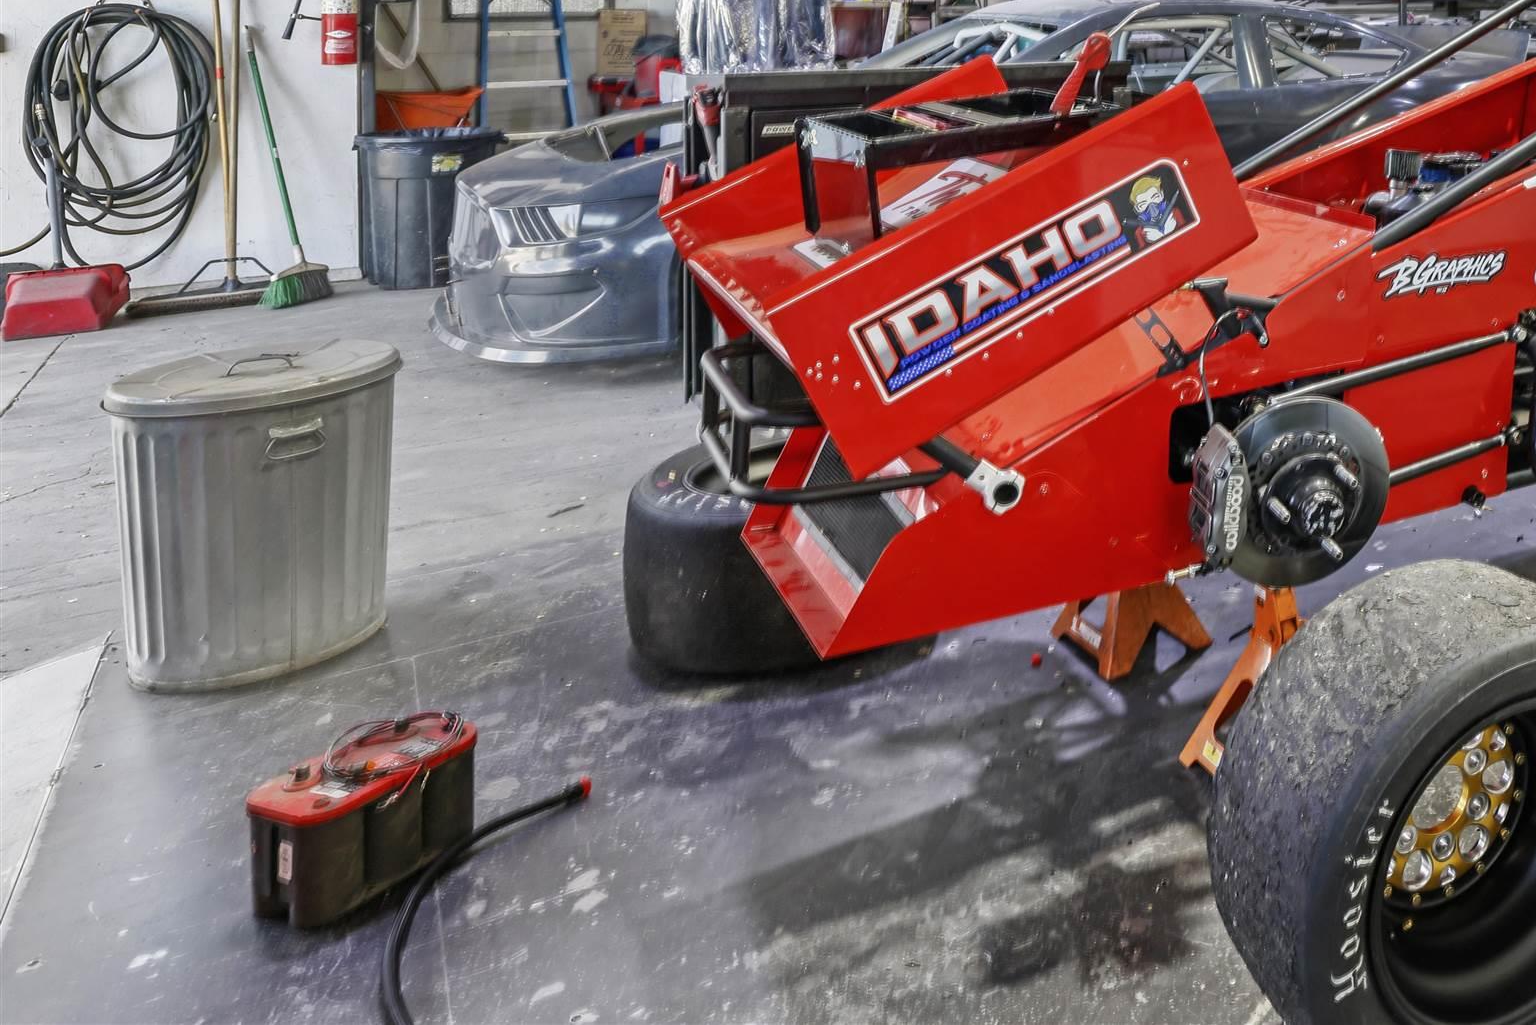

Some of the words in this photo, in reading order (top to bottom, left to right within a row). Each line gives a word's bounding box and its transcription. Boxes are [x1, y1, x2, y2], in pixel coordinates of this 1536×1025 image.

[862, 200, 1122, 379] IDAHO
[900, 326, 962, 368] POWDER
[962, 296, 1020, 333] COATING
[1030, 234, 1128, 294] SANDBLASTING
[1224, 474, 1245, 553] wilwood
